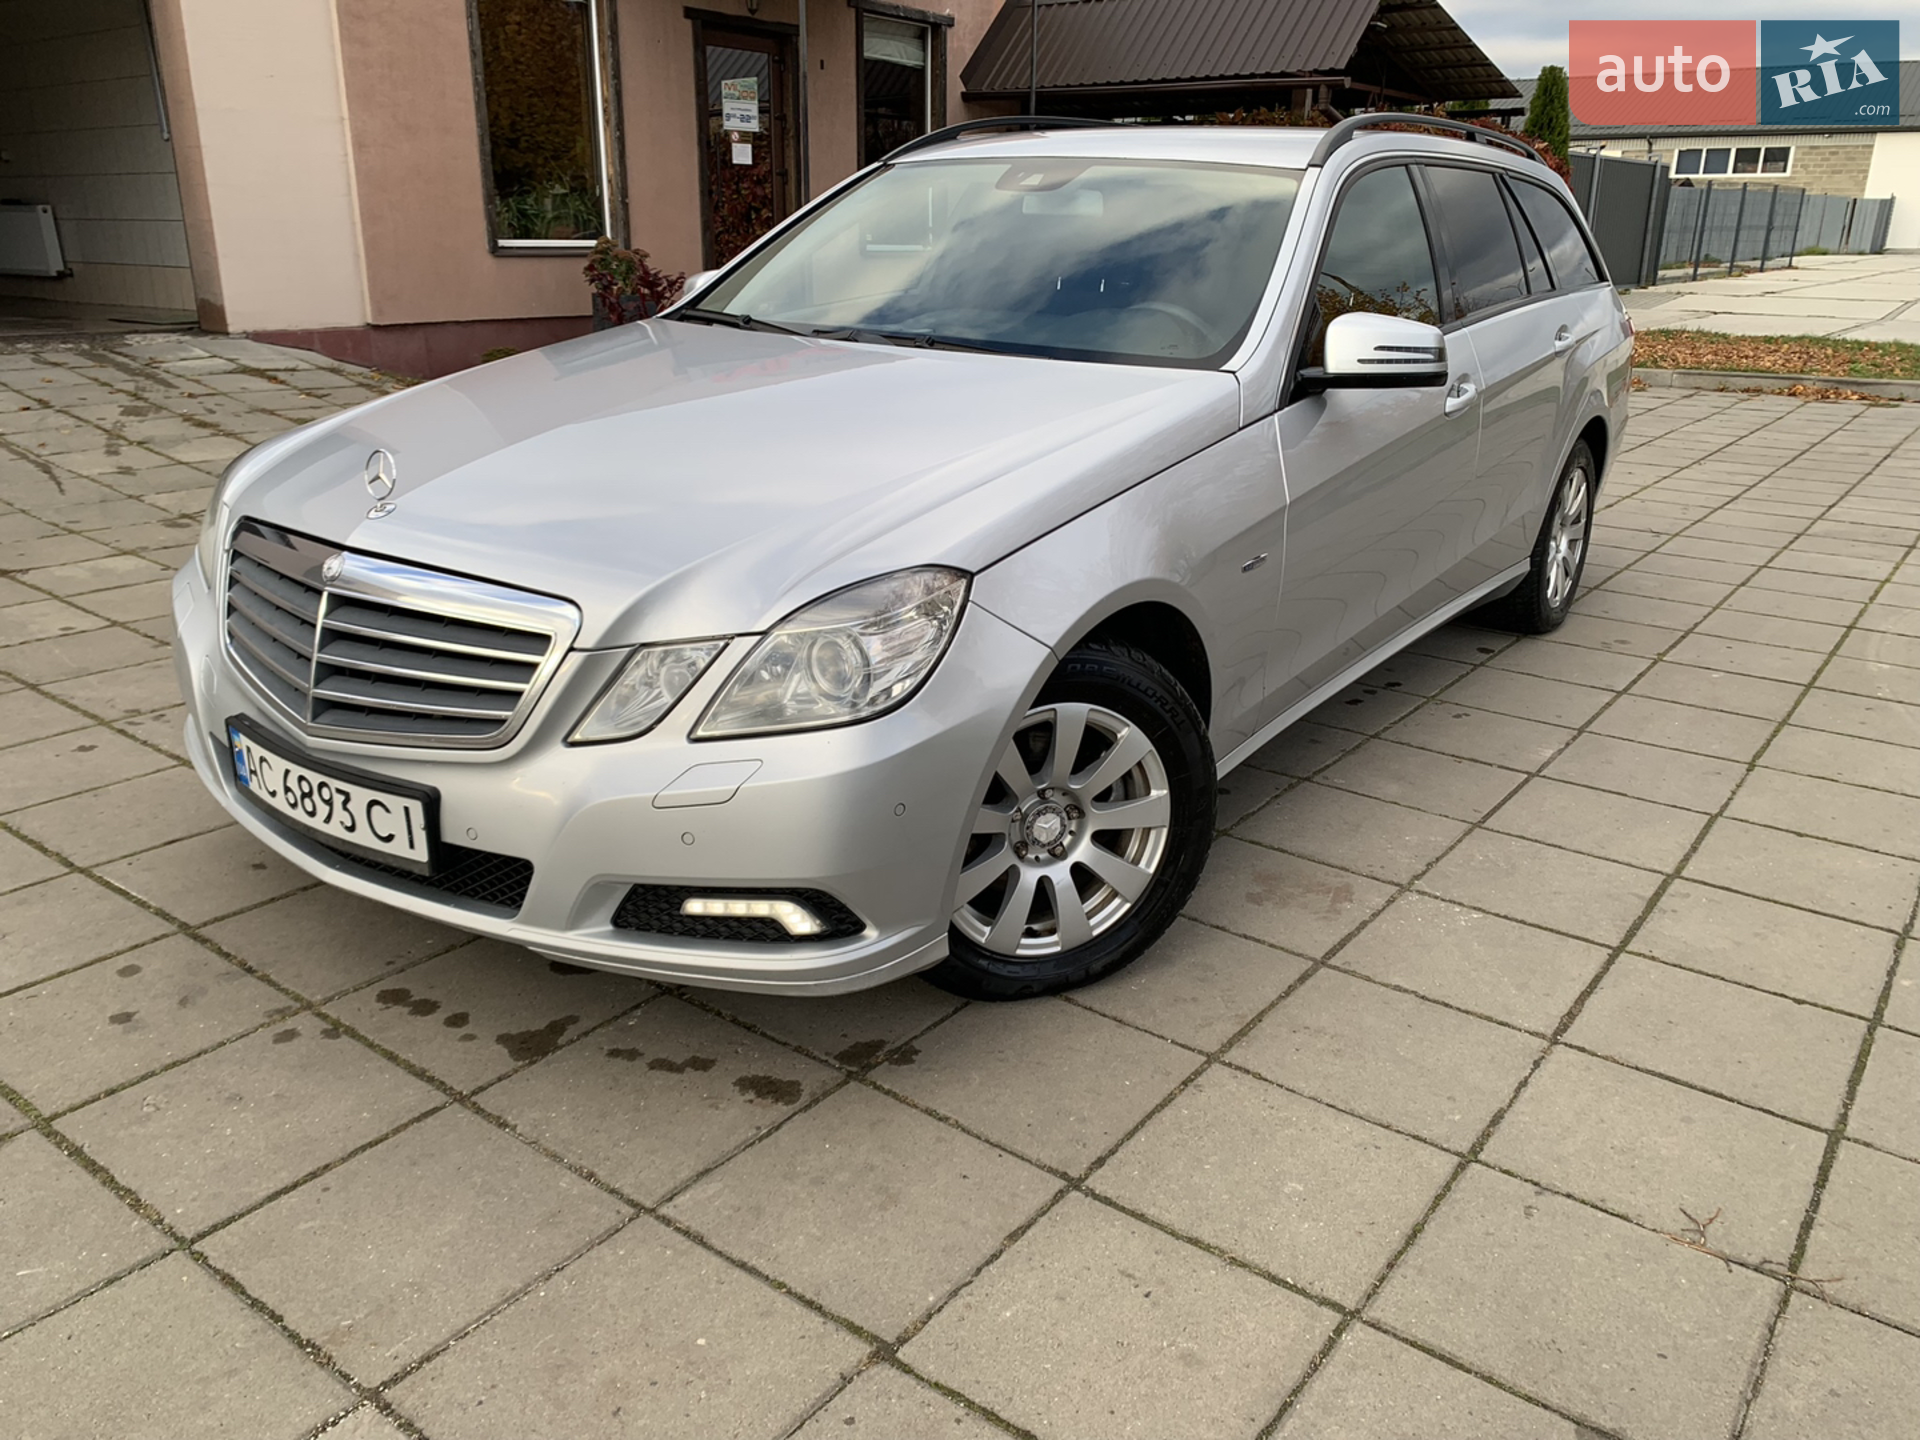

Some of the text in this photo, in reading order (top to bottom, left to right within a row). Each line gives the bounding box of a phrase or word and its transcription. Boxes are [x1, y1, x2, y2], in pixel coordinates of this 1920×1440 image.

[245, 745, 416, 850] AC 6893 CI
